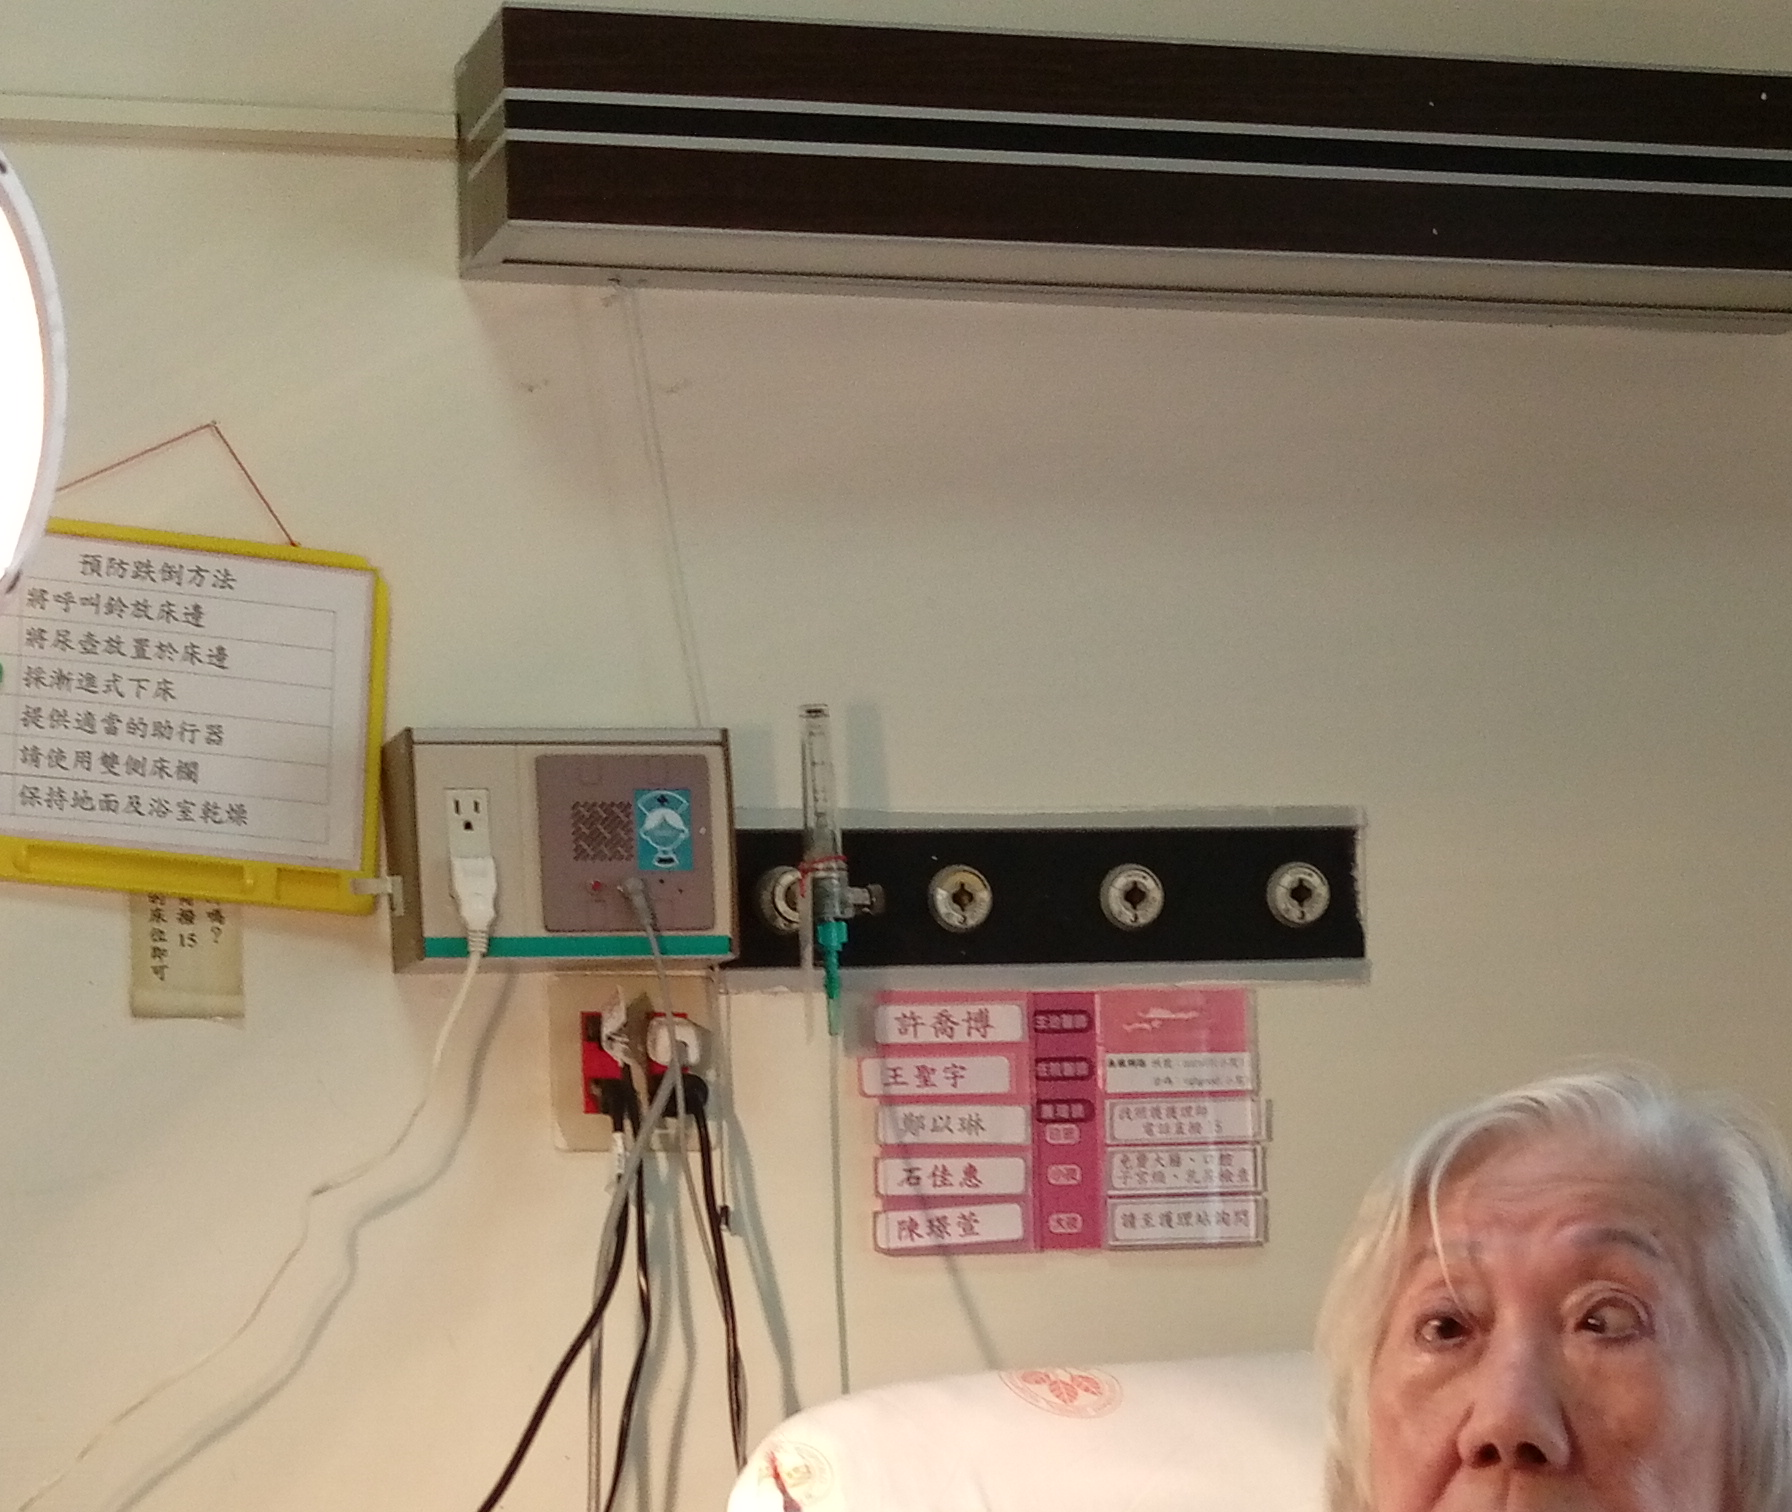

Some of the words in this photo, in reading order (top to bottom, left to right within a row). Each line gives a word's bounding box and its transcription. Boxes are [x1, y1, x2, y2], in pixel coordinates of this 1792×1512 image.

[79, 553, 237, 591] 預防跌倒方法
[26, 587, 206, 629] 將呼叫鈴放床邊
[25, 626, 230, 670] 將尿壺放置於床邊
[22, 665, 178, 701] 採漸進式下床
[20, 704, 225, 747] 提供適當的助行器
[19, 744, 201, 785] 請使用雙側床欄
[18, 784, 249, 827] 保持地面及浴室乾燥
[883, 1062, 968, 1089] 王聖宇
